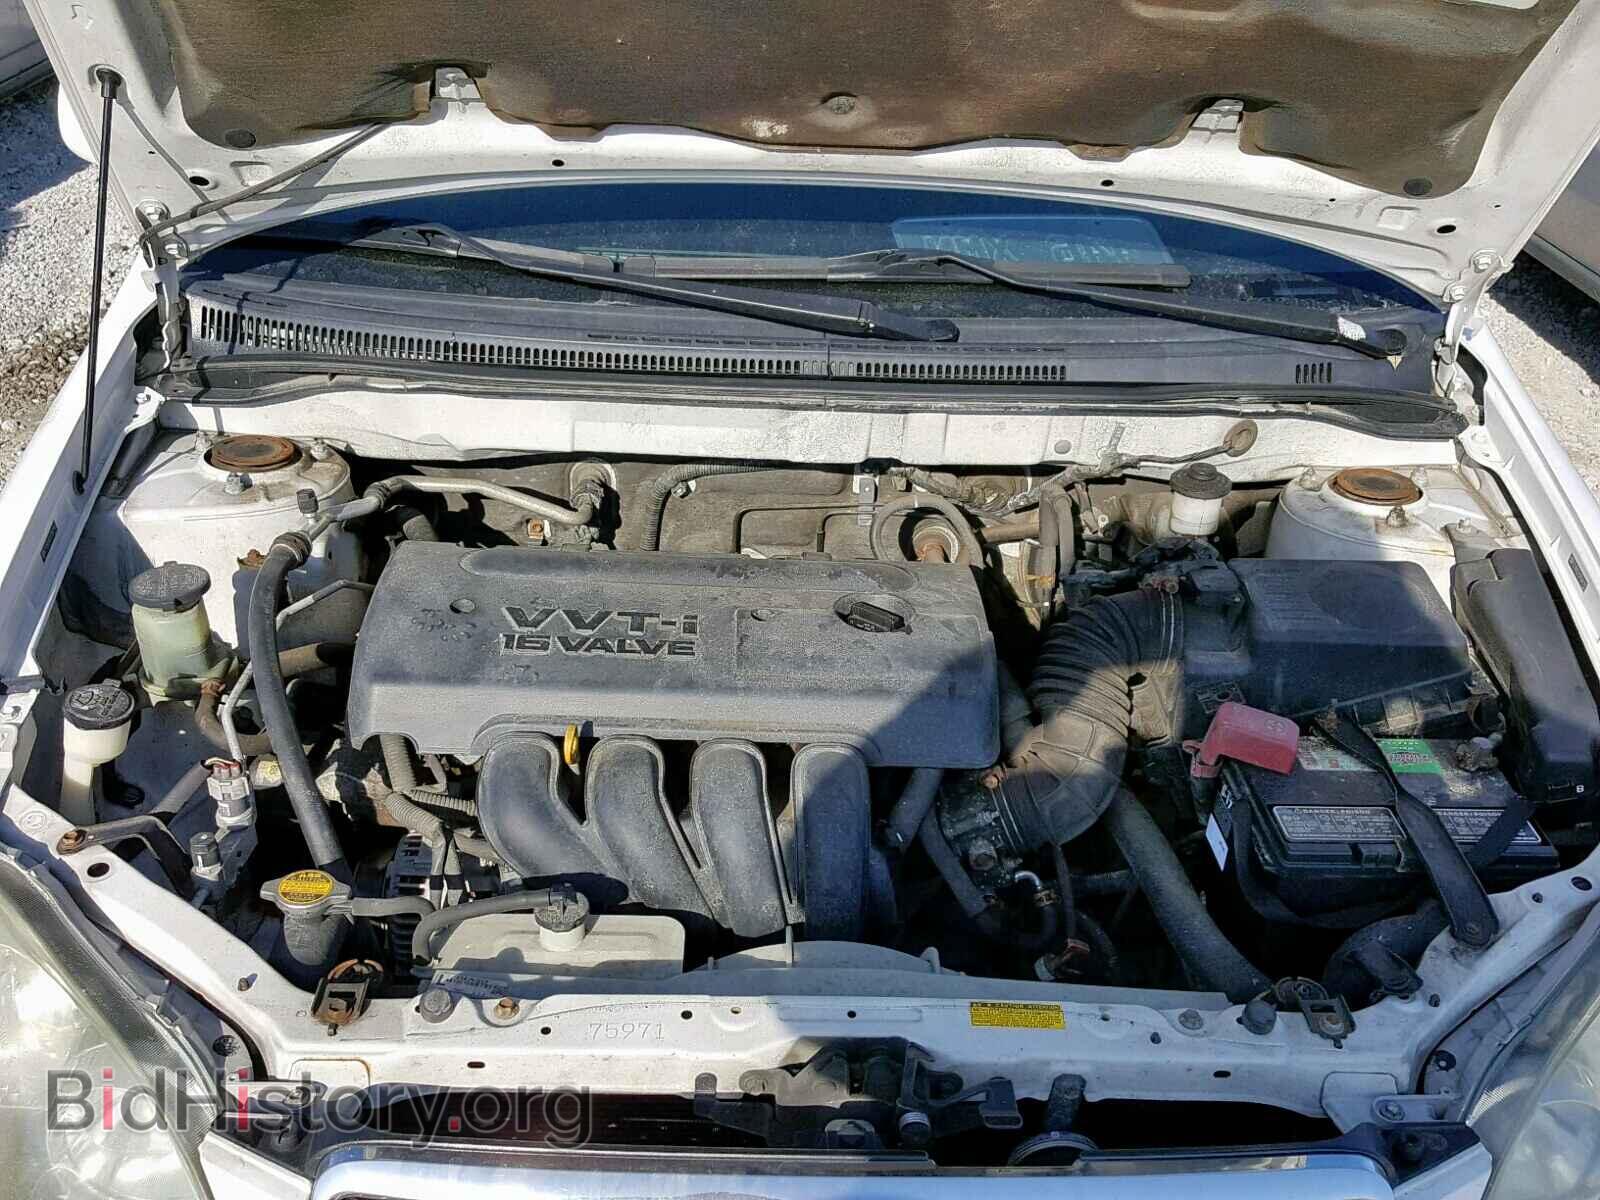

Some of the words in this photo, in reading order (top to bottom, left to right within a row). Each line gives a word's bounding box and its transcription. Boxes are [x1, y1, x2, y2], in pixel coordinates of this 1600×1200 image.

[501, 606, 699, 636] VVT-i
[555, 635, 698, 658] VALVE
[589, 1021, 665, 1040] 75971
